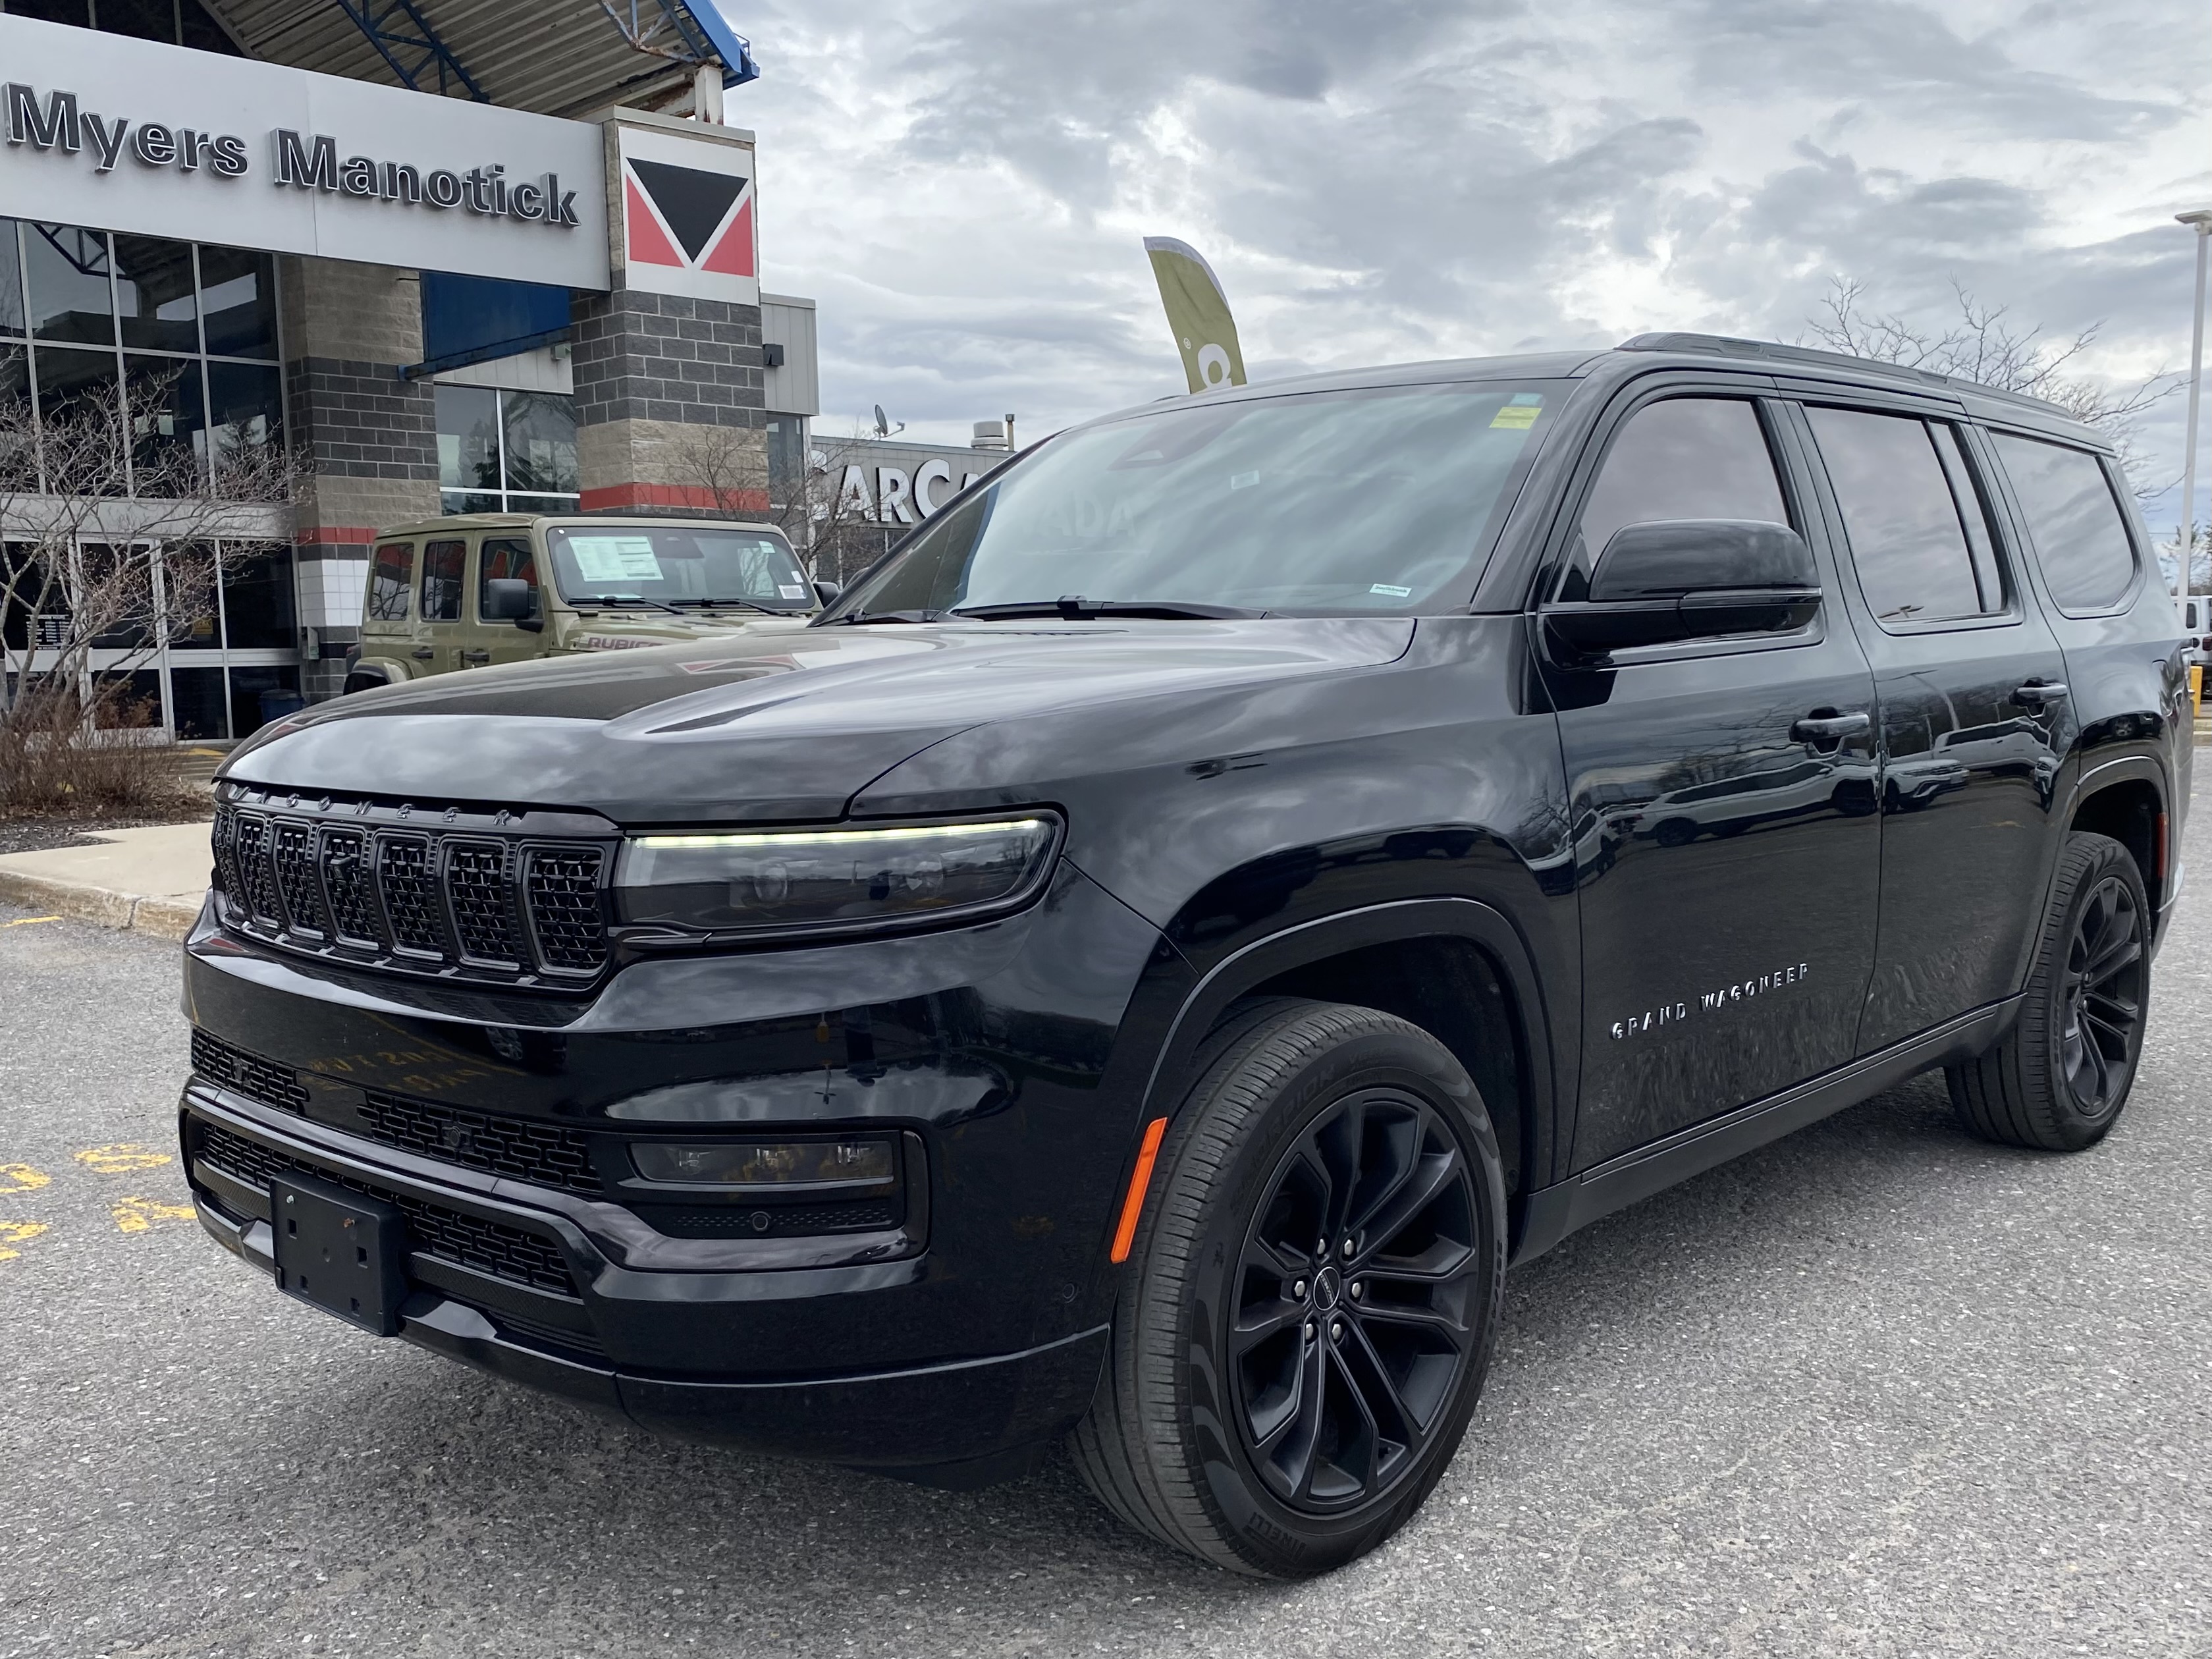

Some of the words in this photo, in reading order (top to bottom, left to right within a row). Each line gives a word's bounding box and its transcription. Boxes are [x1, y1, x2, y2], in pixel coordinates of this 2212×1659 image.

[3, 82, 250, 177] Myers
[271, 128, 581, 227] Manotick
[588, 637, 662, 649] RUBIC
[229, 784, 511, 826] WAGONEER
[1611, 1002, 1686, 1039] GRAND
[1700, 963, 1808, 1012] WAGONEER
